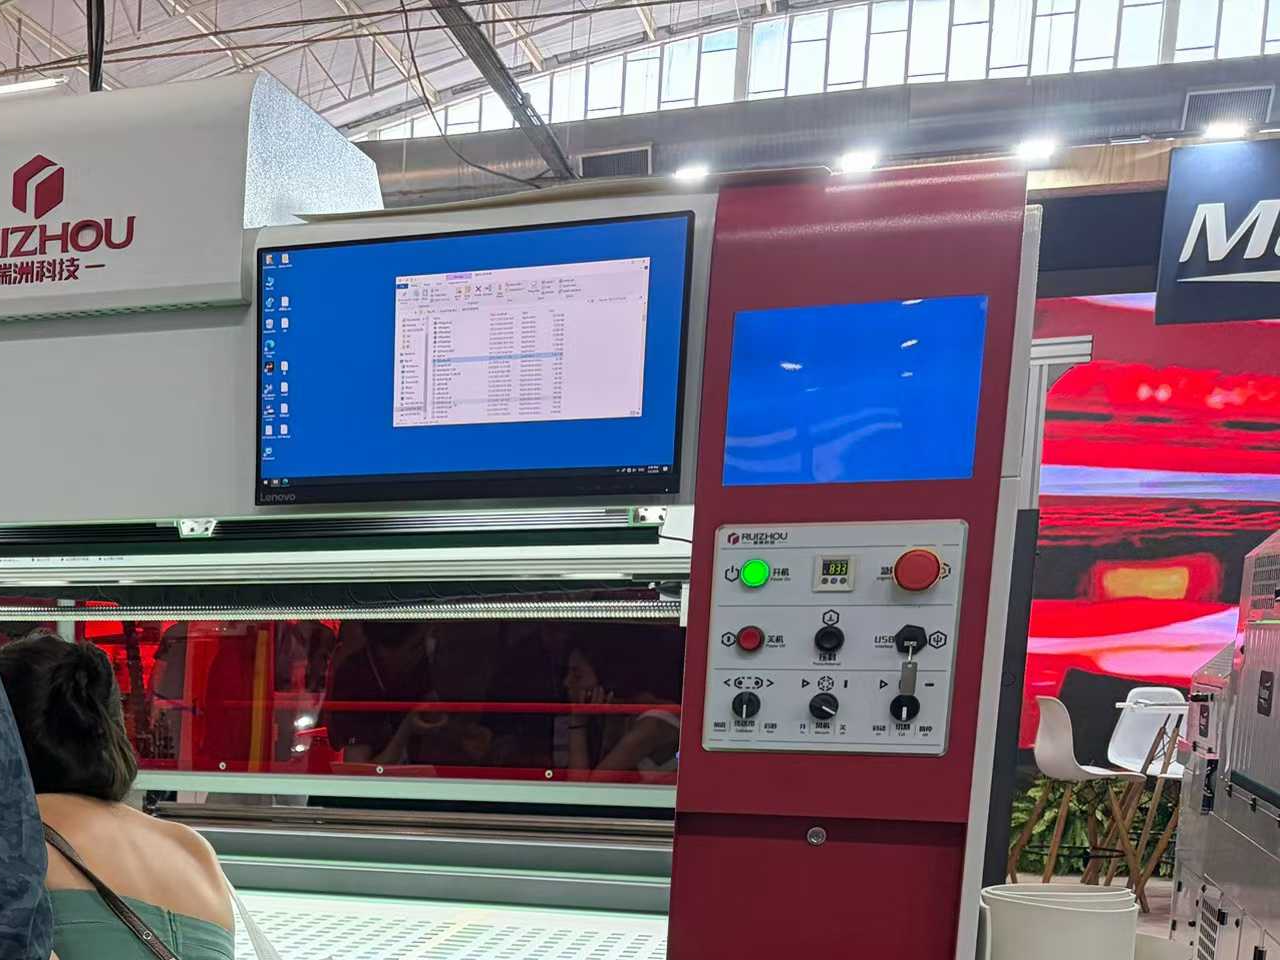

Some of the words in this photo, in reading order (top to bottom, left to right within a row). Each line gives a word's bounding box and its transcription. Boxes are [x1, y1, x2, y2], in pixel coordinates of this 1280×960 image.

[1178, 199, 1280, 262] M
[260, 492, 296, 502] Lenovo
[741, 532, 788, 541] RUIZHOU
